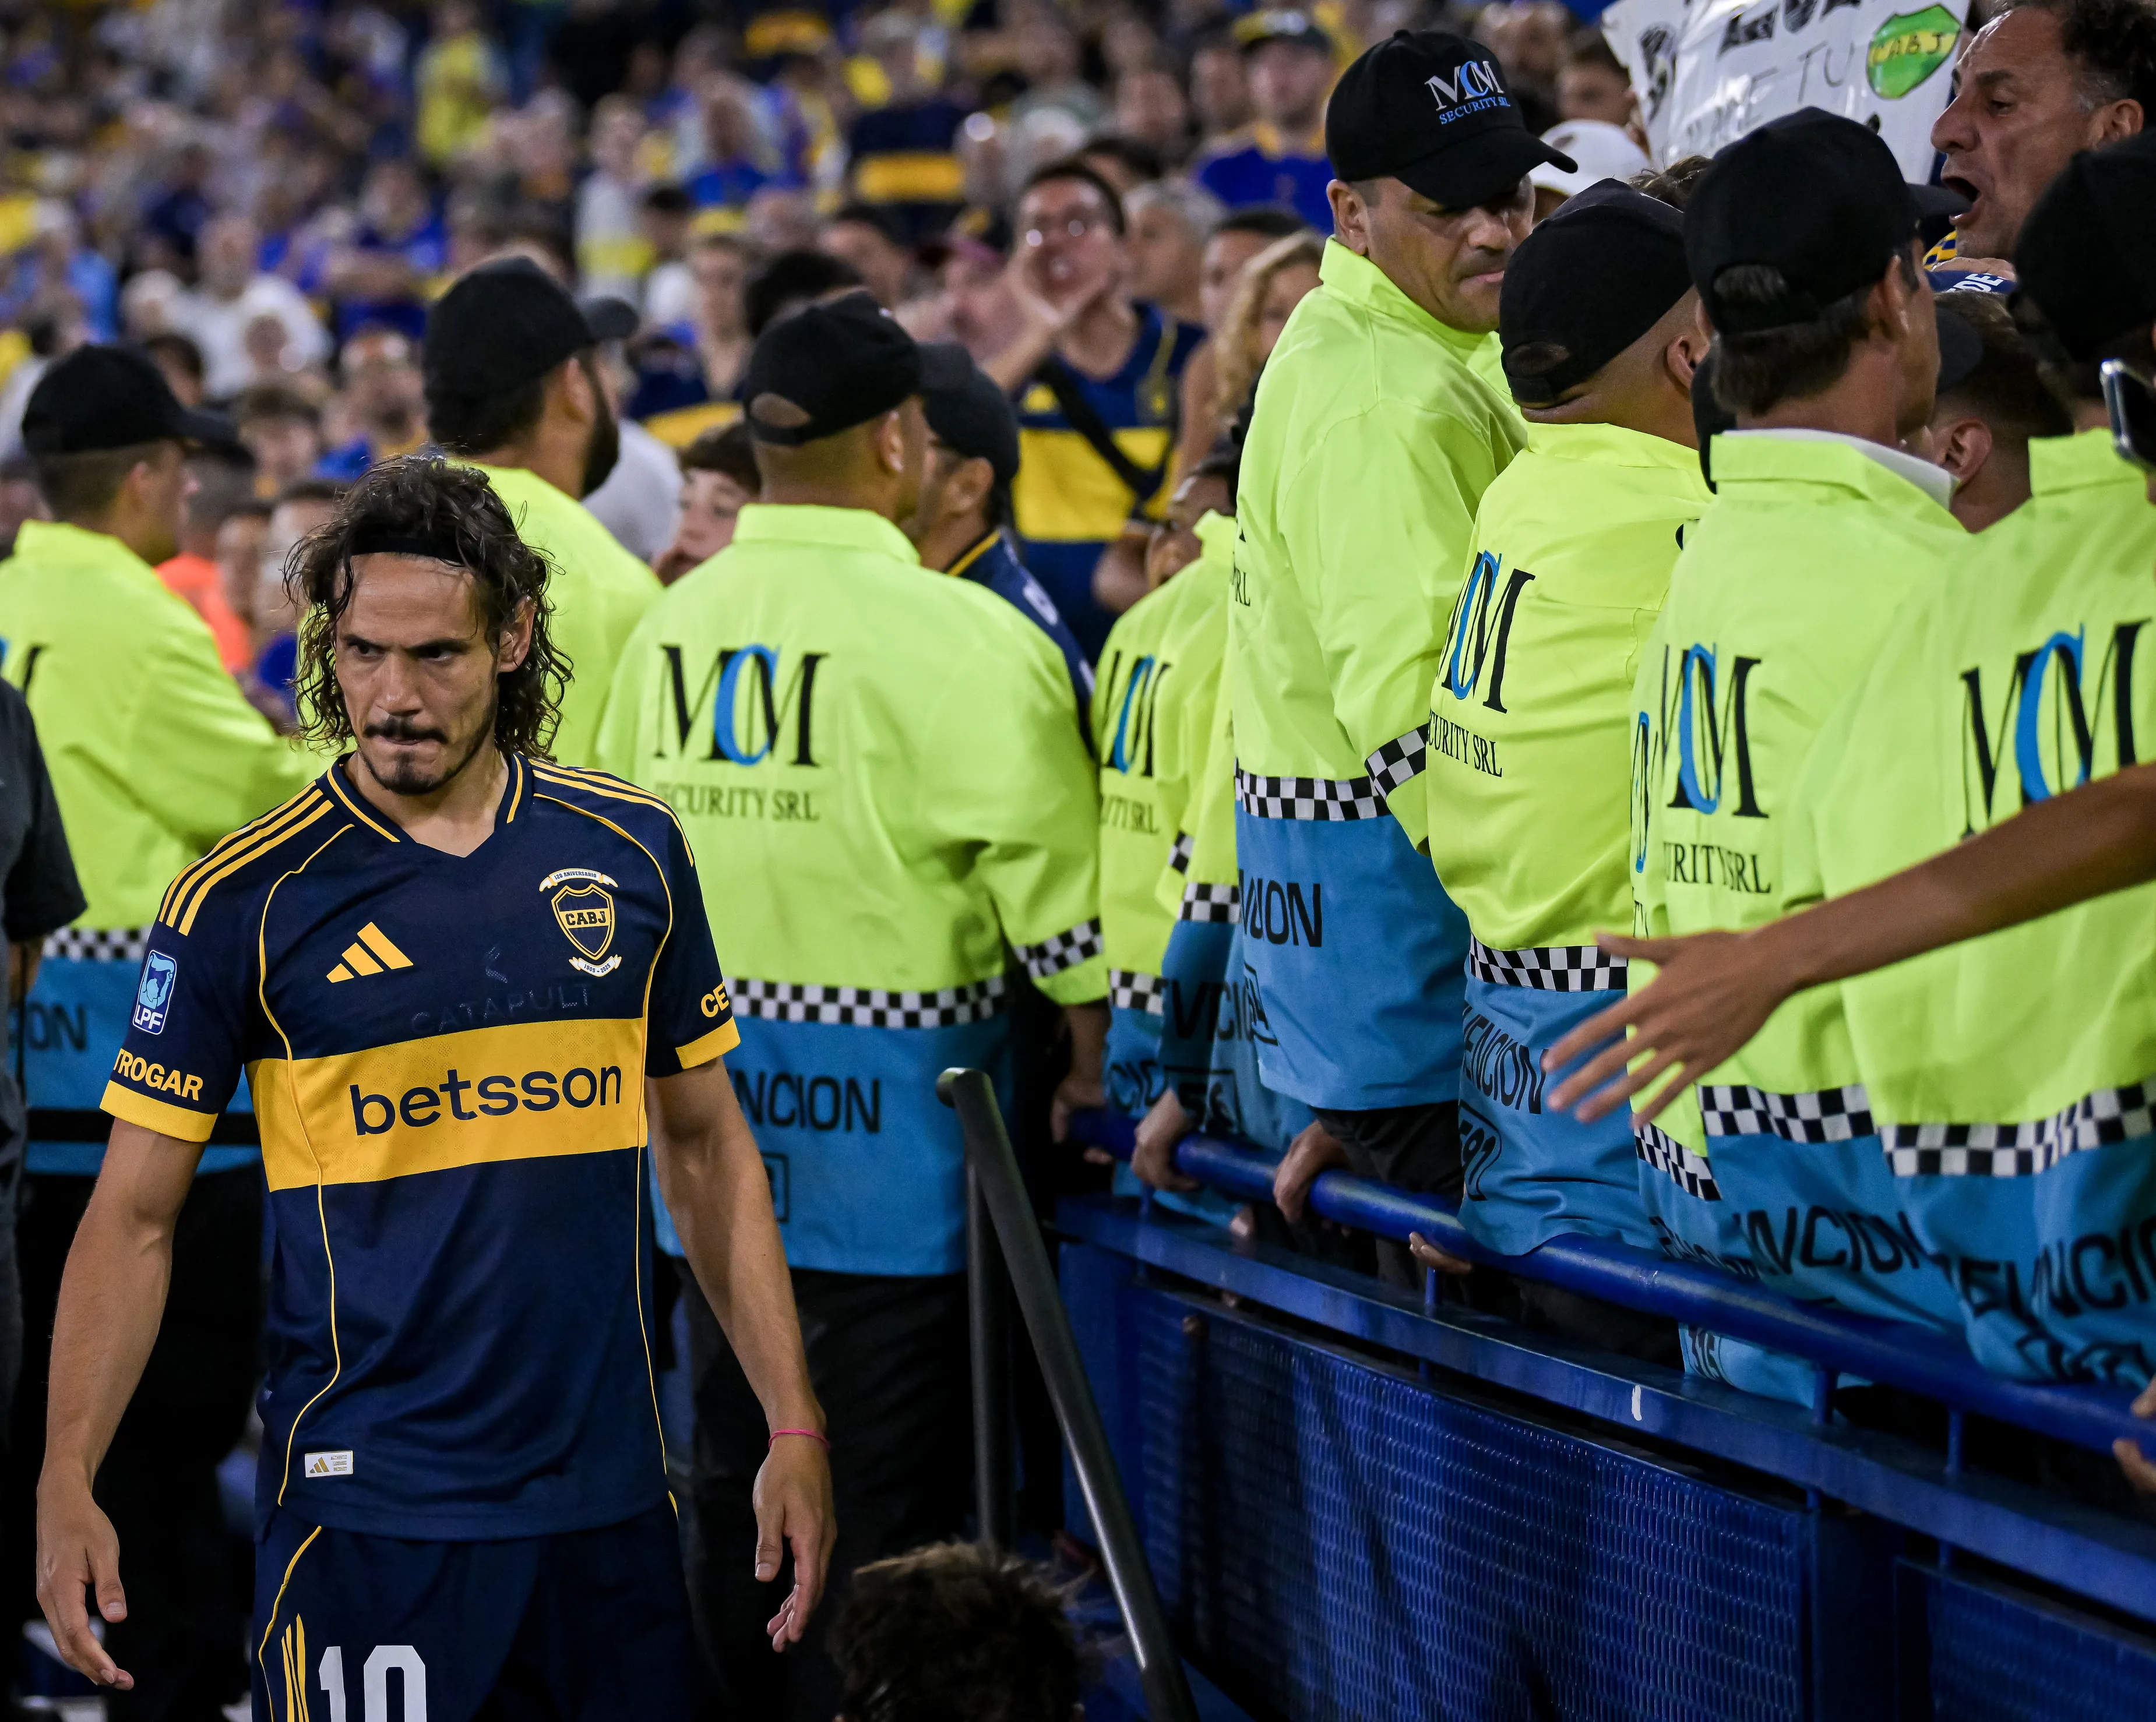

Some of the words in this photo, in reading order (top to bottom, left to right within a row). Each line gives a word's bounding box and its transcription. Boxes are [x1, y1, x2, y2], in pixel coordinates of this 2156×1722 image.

[1439, 97, 1498, 125] SECURITY
[654, 644, 830, 768] MCM
[1959, 616, 2152, 842] MCM
[1428, 708, 1469, 764] CURITY
[1472, 734, 1502, 778] SRL
[771, 789, 819, 821] SRL
[565, 911, 606, 926] CABJ
[600, 963, 611, 973] 2025
[135, 1004, 163, 1030] LPF
[350, 1065, 621, 1136] betsson
[319, 1646, 427, 1722] 10
